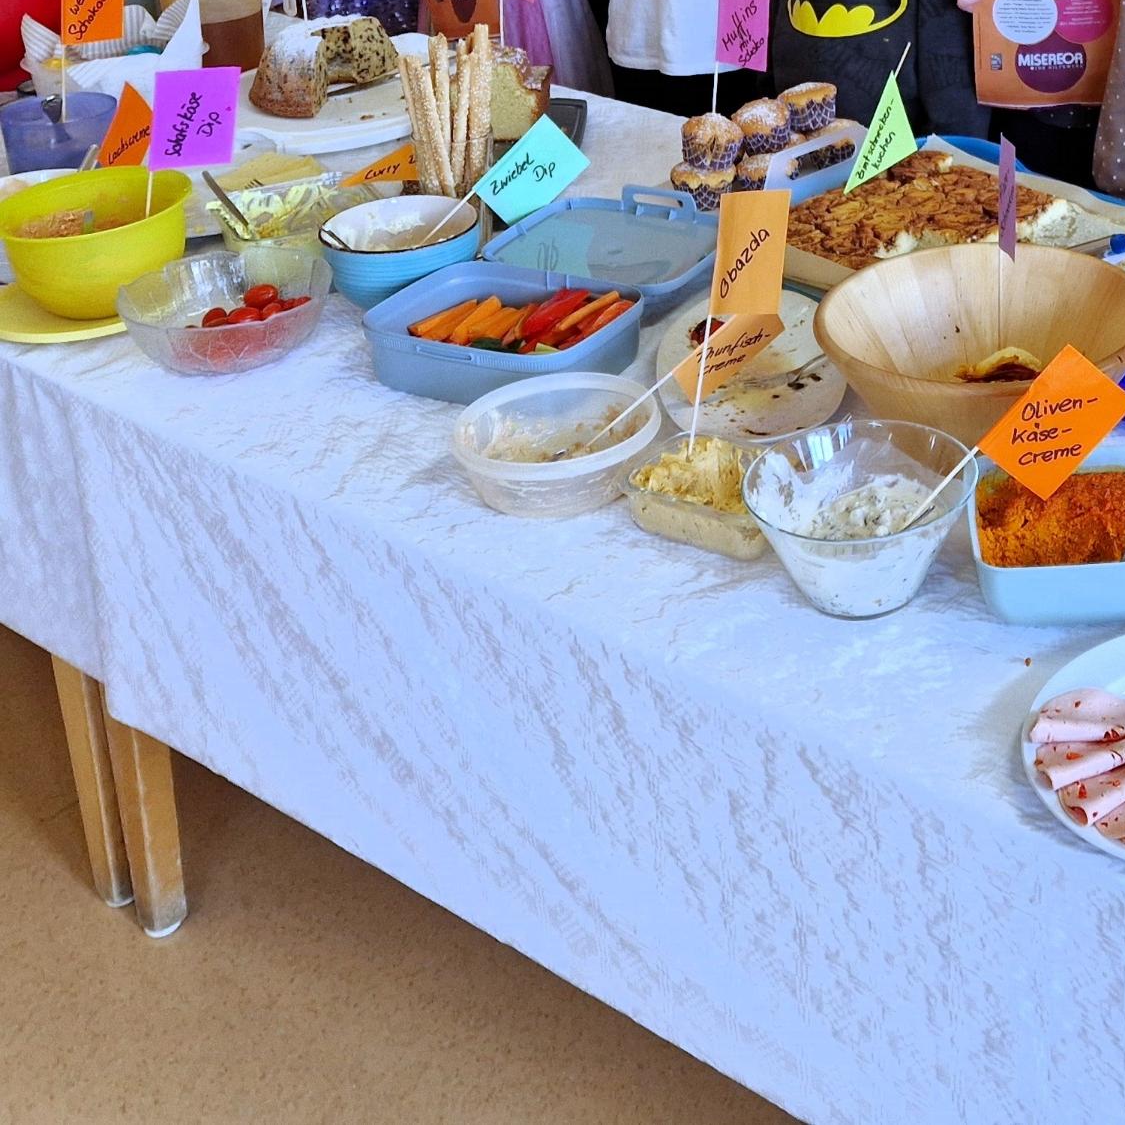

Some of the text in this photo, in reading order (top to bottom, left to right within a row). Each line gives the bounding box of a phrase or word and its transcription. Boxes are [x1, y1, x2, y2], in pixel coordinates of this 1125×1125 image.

[721, 0, 758, 52] Muffins
[1017, 52, 1083, 67] MISEREOR
[196, 111, 222, 137] Dip
[364, 162, 401, 181] Curry
[489, 152, 535, 196] Zwiebel
[532, 160, 556, 183] Dip
[719, 227, 770, 300] Obazda
[1021, 397, 1099, 421] Oliven-
